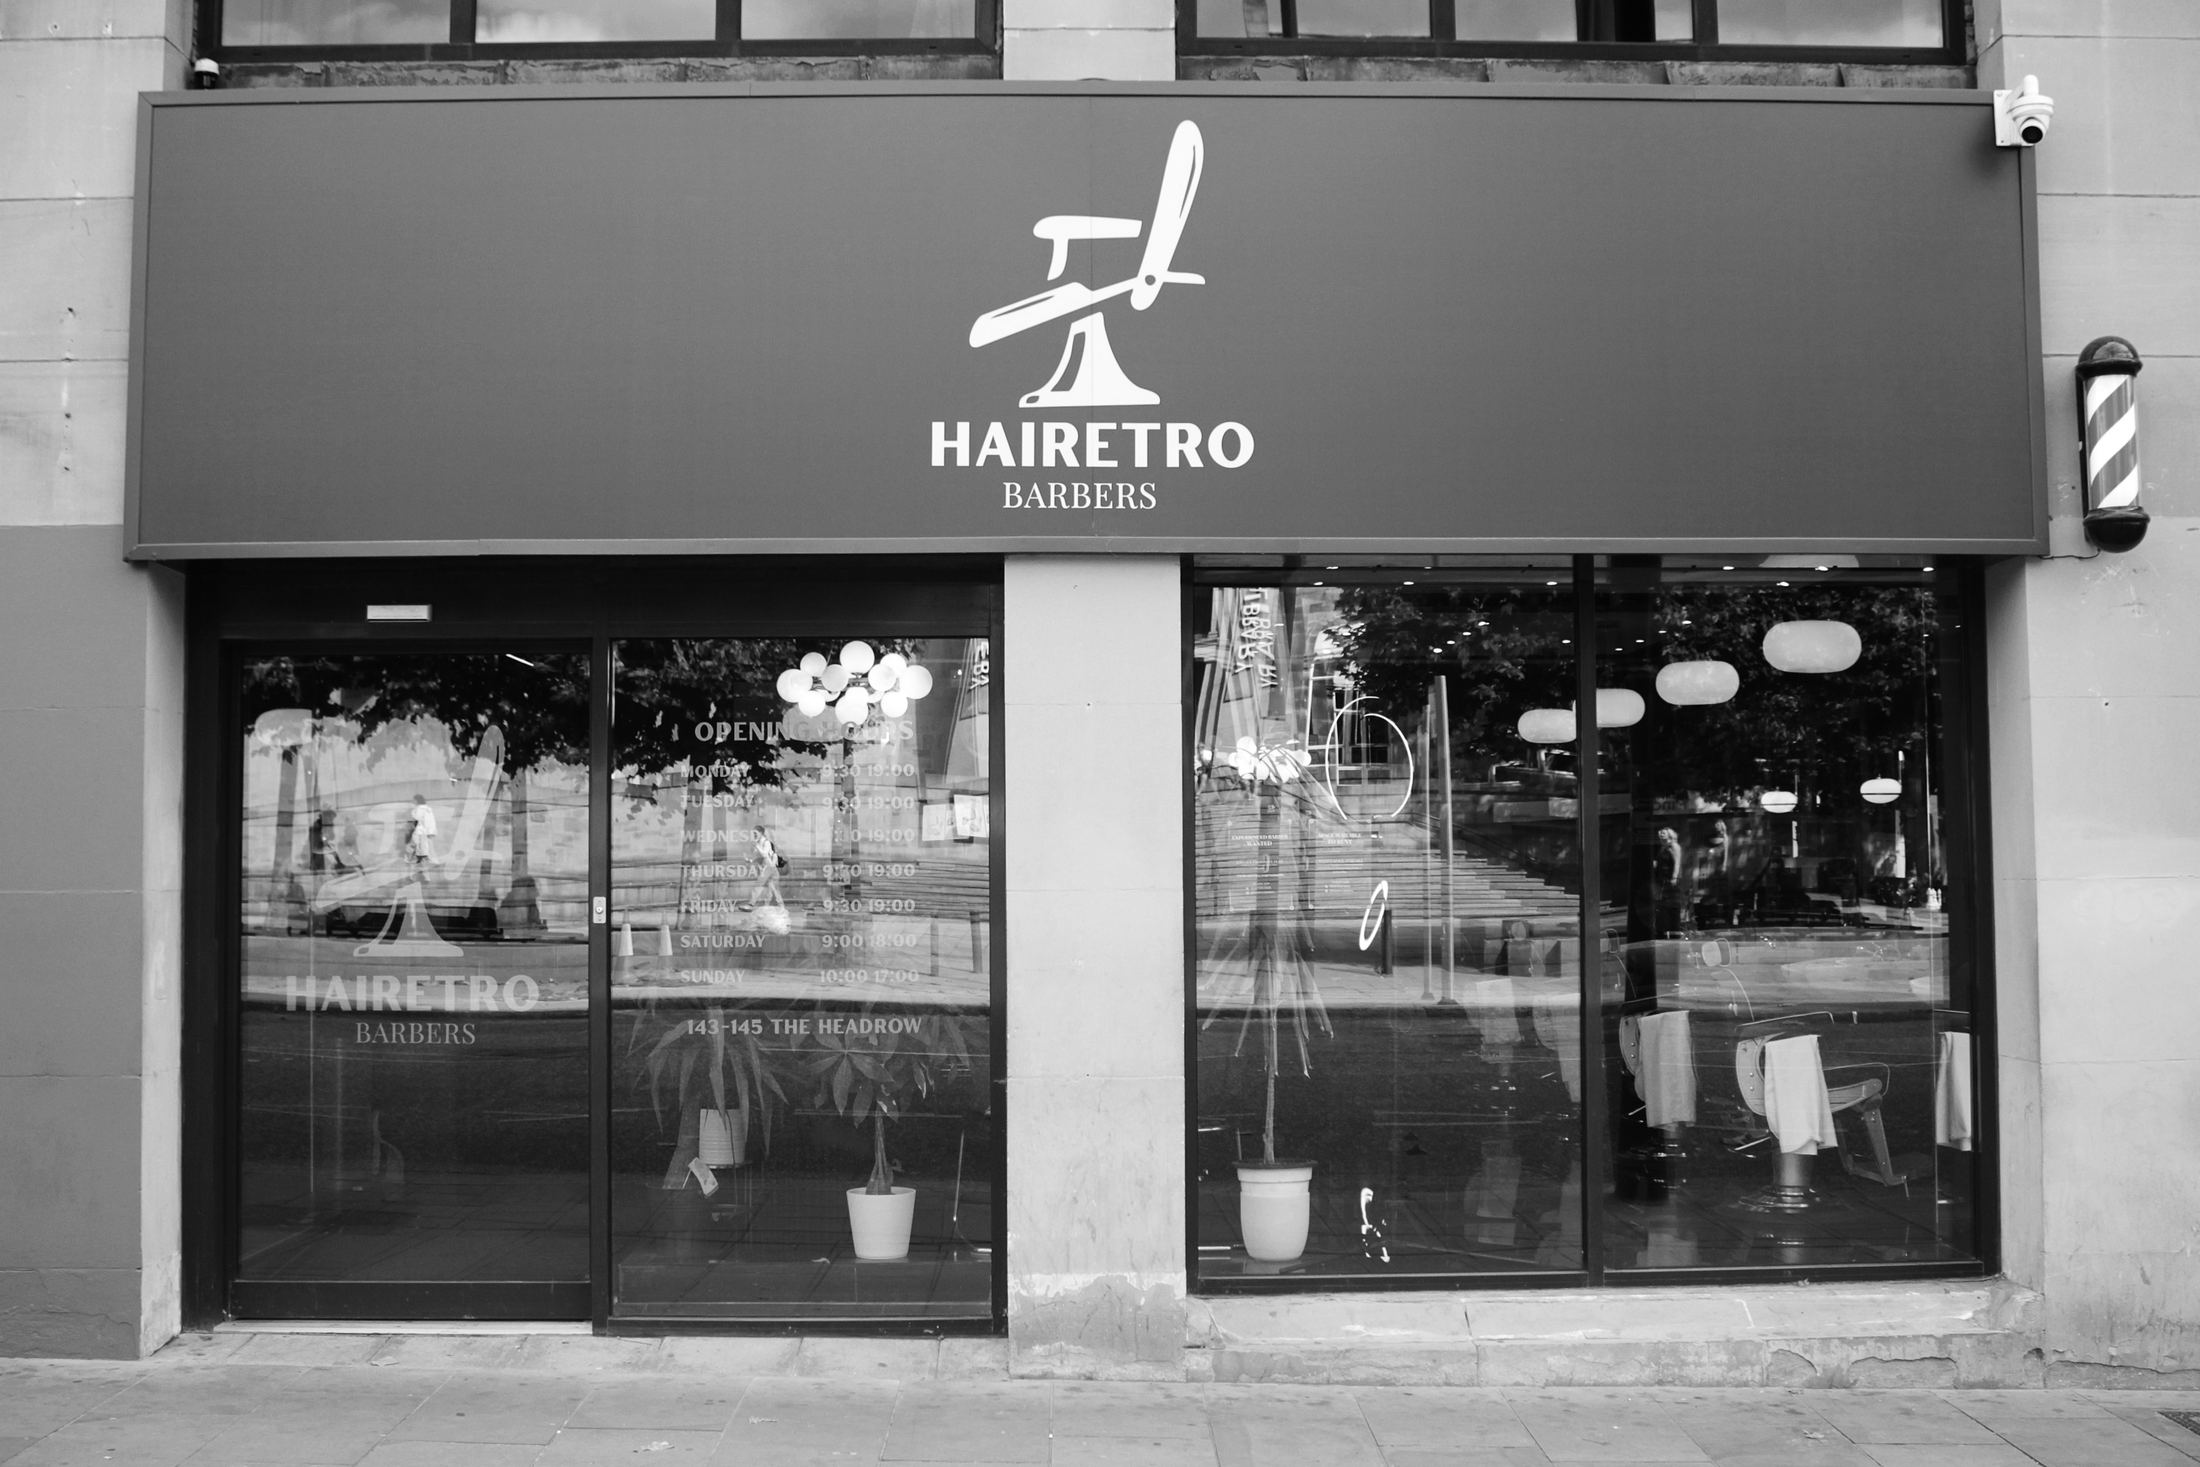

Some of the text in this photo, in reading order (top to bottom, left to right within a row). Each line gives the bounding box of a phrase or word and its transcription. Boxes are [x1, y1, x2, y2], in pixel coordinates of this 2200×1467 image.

[931, 421, 1255, 468] HAIRETRO
[1002, 481, 1157, 510] BARBERS
[694, 721, 812, 742] OPENING
[680, 763, 915, 778] MONDAY 9:30 19:00
[680, 794, 915, 809] TUESDAY 9:30 19:00
[680, 829, 776, 843] WEDNESD
[868, 829, 916, 842] 19:00
[681, 864, 768, 878] THURSDAY
[868, 864, 916, 877] 19:00
[681, 899, 916, 913] FRIDAY 9:30 19:00
[680, 934, 917, 949] SATURDAY 9:00 18:00
[680, 969, 920, 984] SUNDAY 10:00 17:00
[286, 975, 540, 1012] HAIRETRO
[356, 1022, 476, 1045] BARBERS
[687, 1017, 922, 1035] 143-145 THE HEADROW
